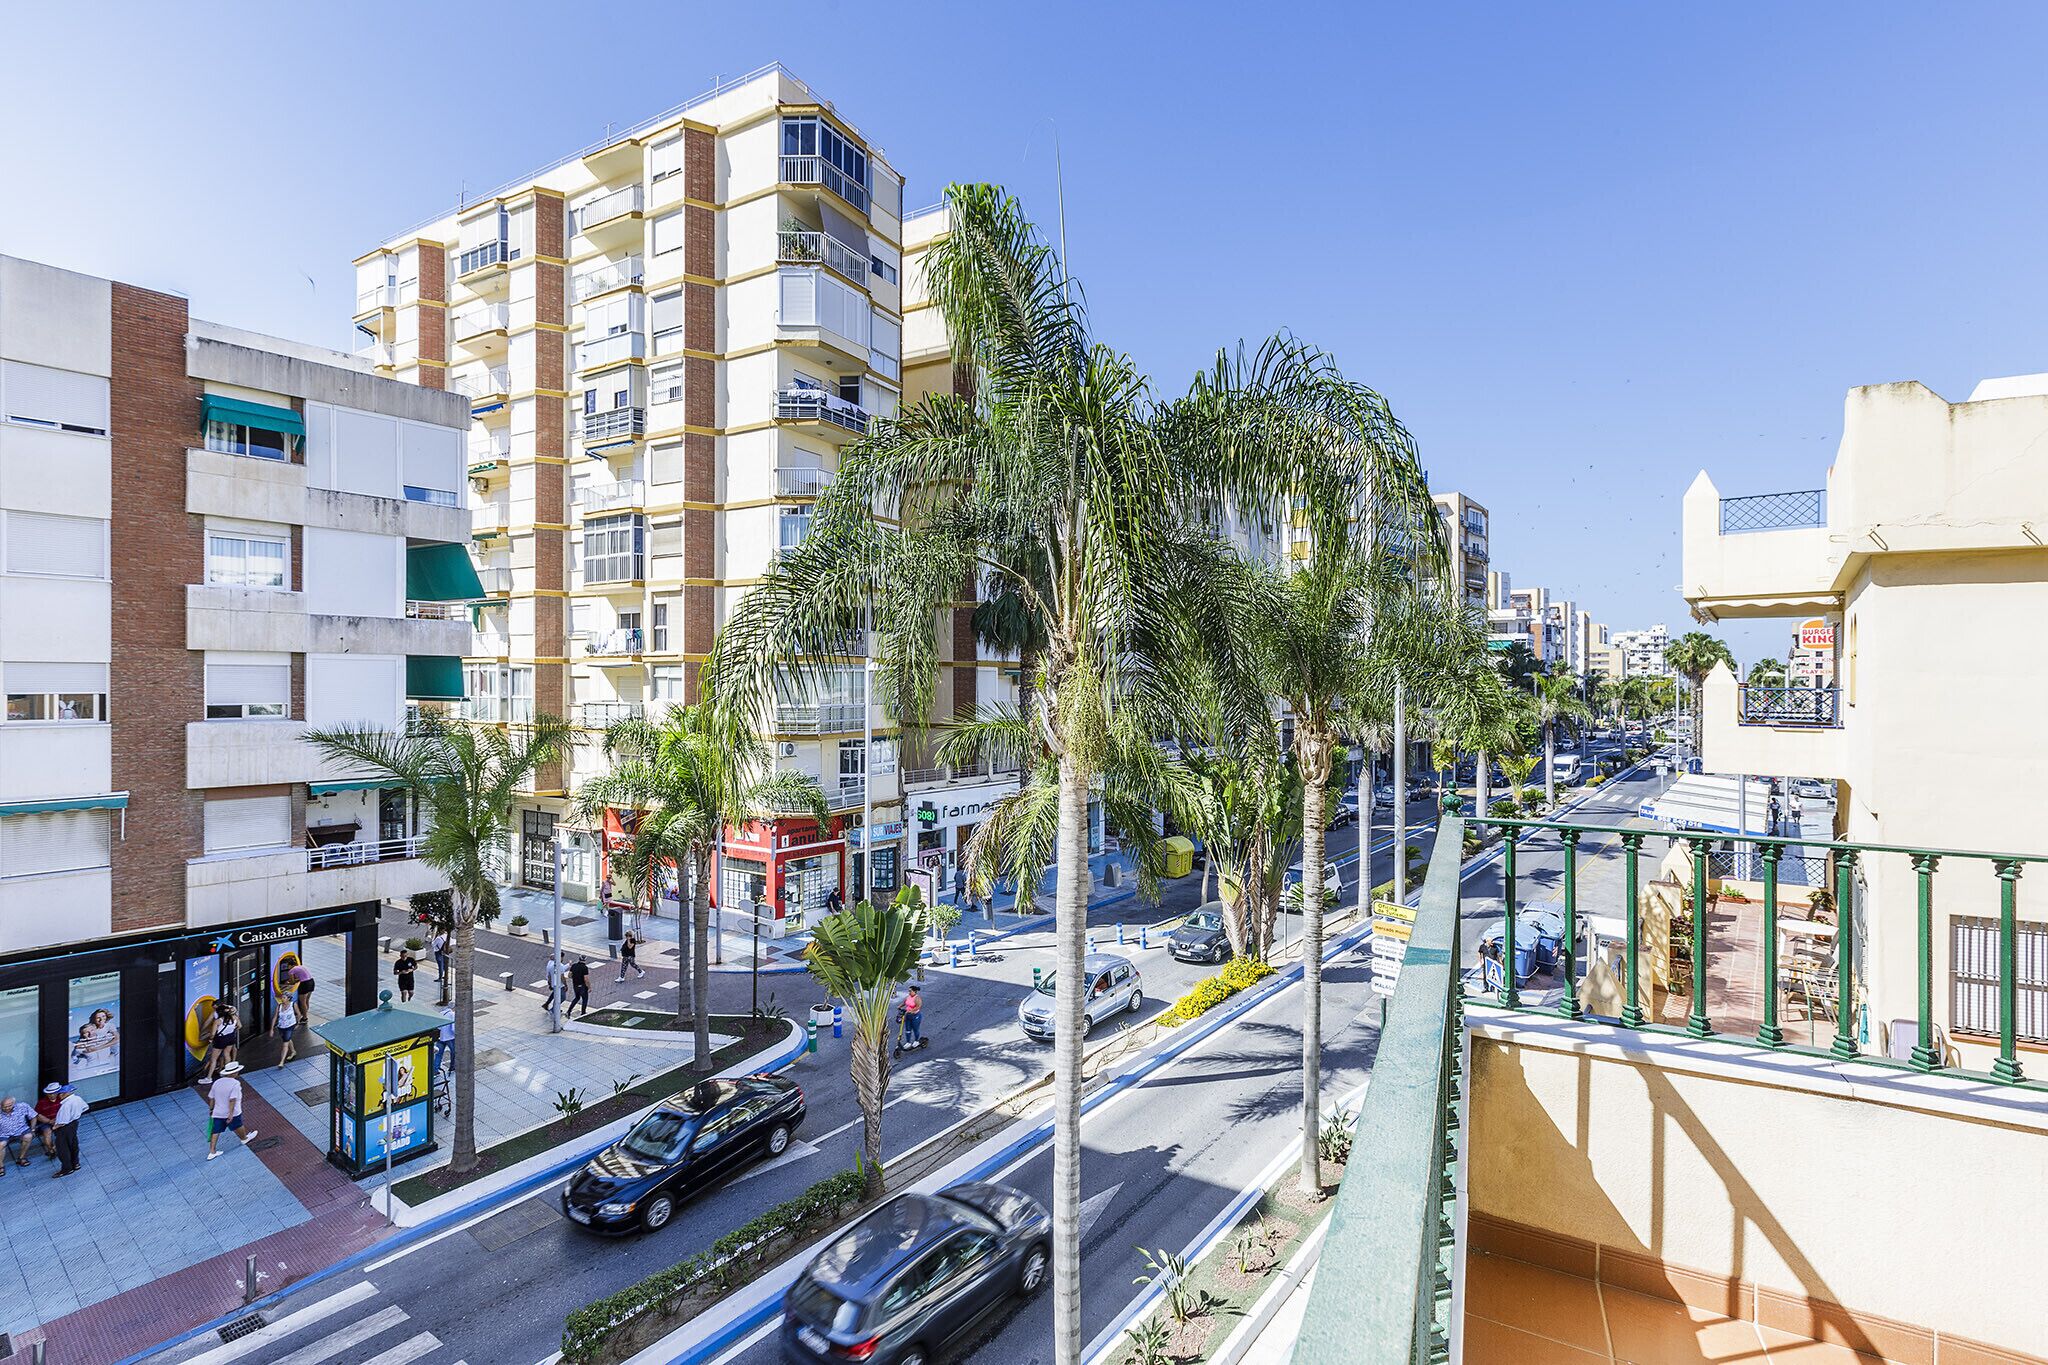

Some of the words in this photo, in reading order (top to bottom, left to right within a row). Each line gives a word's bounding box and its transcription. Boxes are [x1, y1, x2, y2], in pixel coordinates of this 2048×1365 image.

[884, 823, 903, 836] VIAJES
[1377, 903, 1398, 912] Oficina
[239, 923, 308, 944] CaixaBank
[383, 1136, 411, 1154] JGADO
